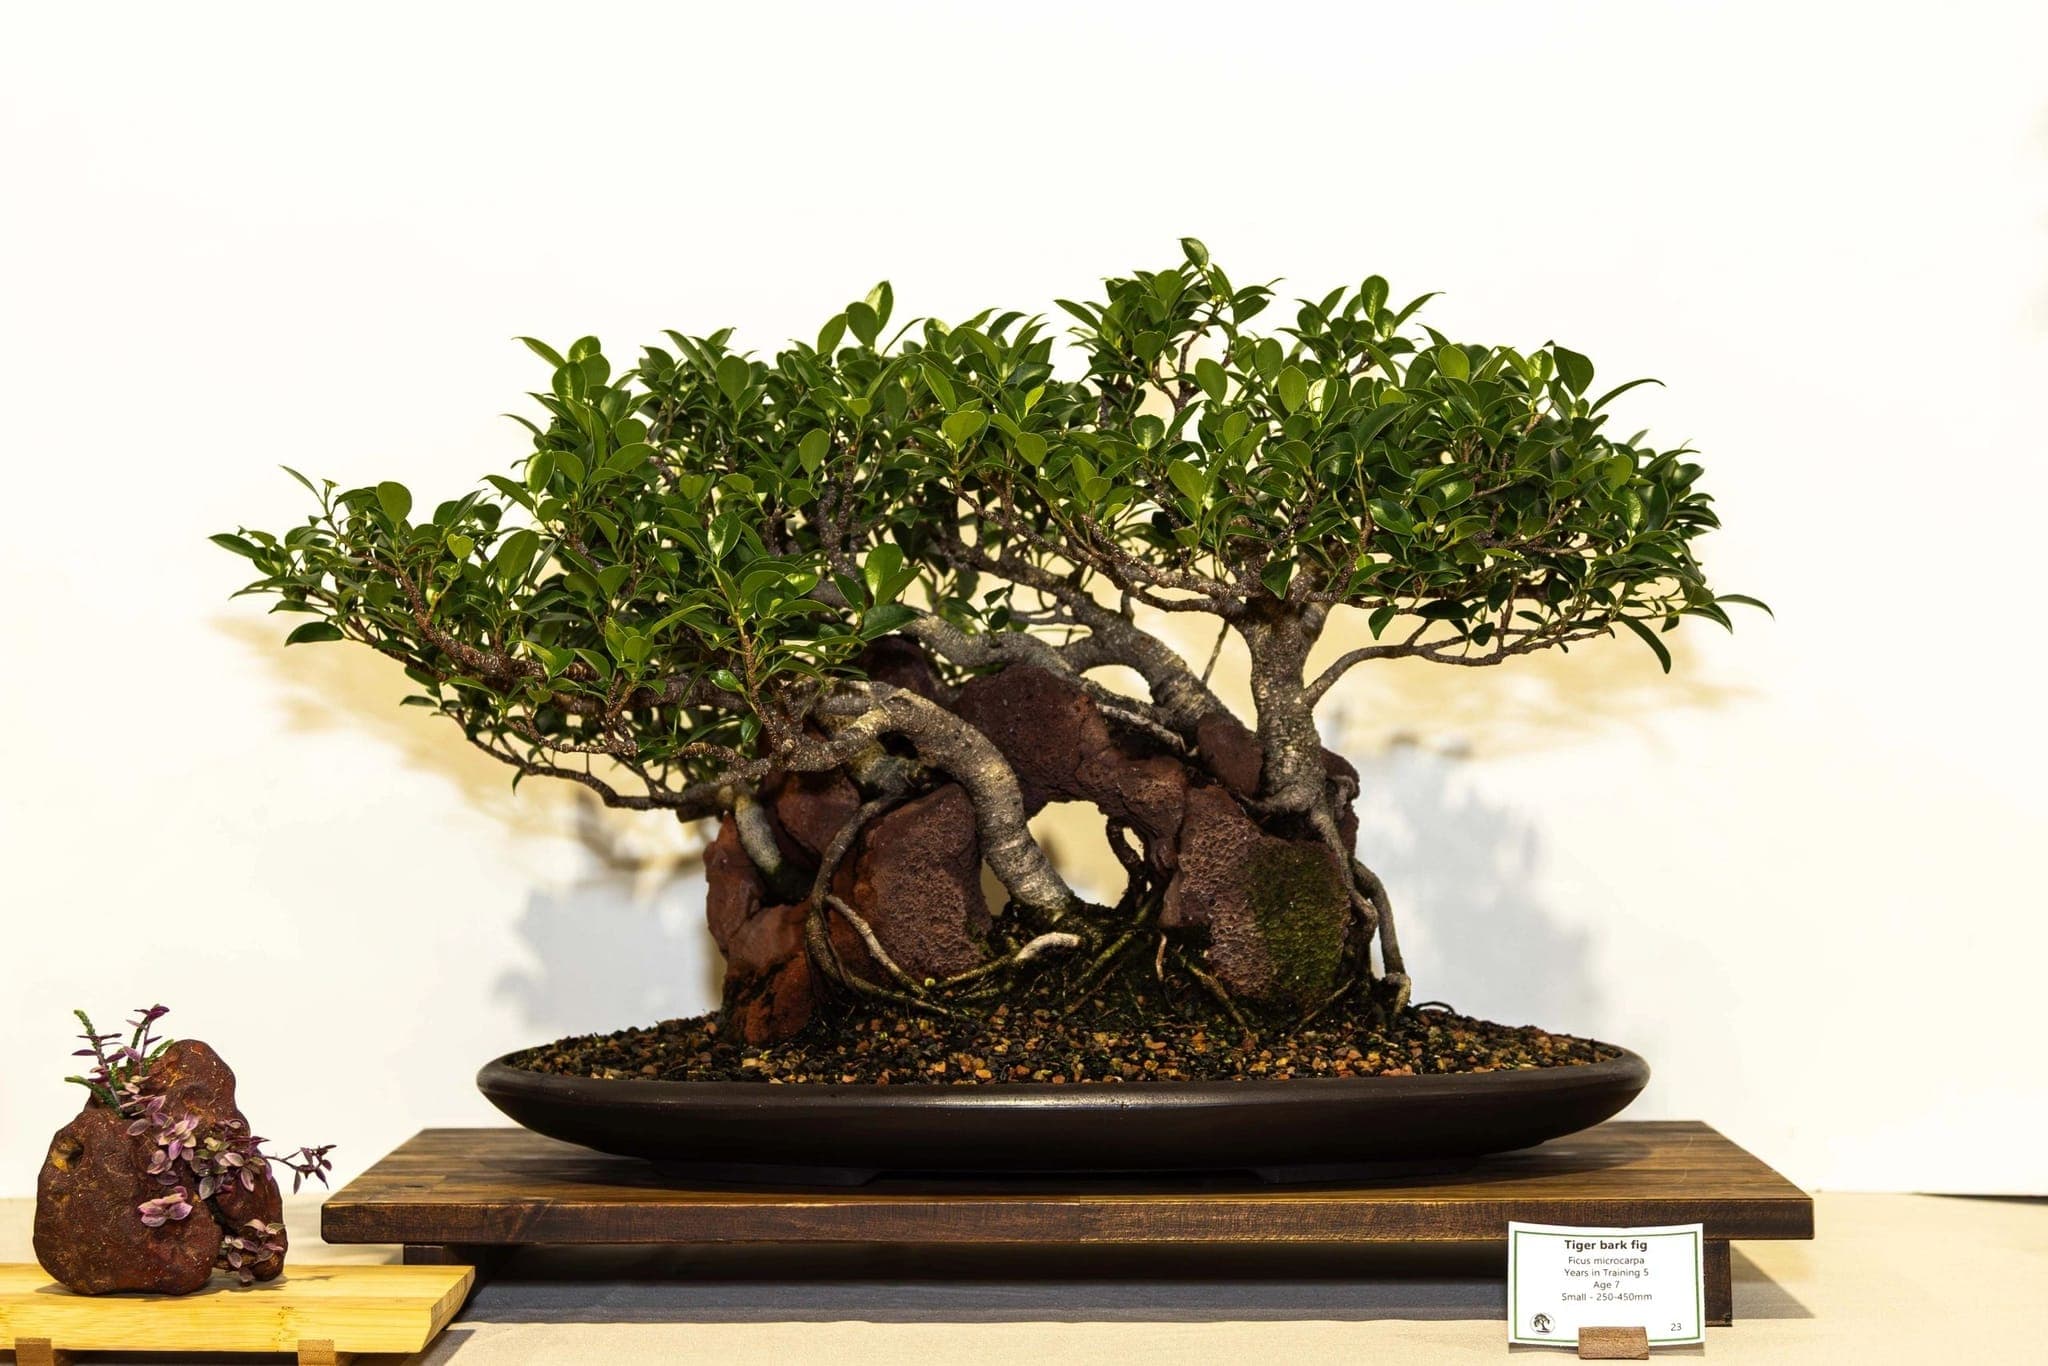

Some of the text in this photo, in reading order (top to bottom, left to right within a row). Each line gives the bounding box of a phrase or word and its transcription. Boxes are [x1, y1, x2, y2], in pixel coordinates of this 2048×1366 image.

[1564, 1239, 1648, 1252] Tiger bark fig
[1568, 1256, 1645, 1267] Ficus microcarpa
[1564, 1268, 1649, 1279] Years in Training 5
[1593, 1281, 1620, 1291] Age 7
[1561, 1292, 1587, 1301] Small
[1596, 1293, 1653, 1301] 250-450mm
[1670, 1323, 1682, 1332] 23
